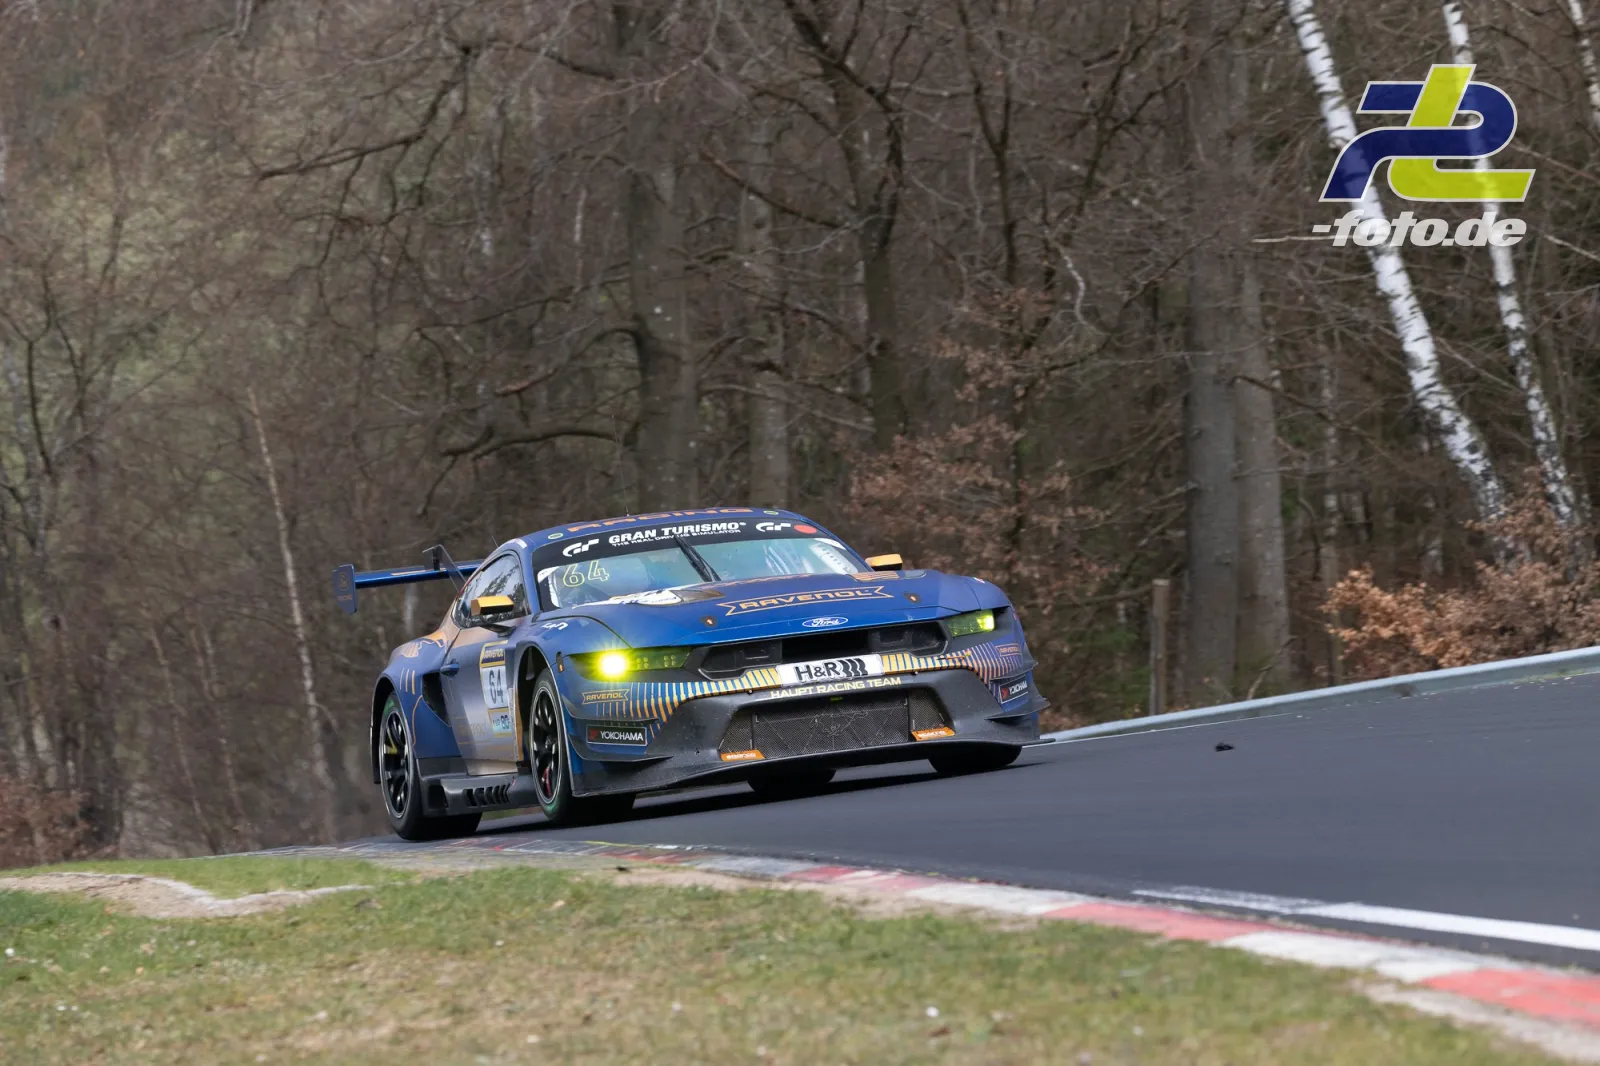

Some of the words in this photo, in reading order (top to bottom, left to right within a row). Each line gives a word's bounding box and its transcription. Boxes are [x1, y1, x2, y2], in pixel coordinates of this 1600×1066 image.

[608, 529, 657, 544] GRAN
[661, 522, 740, 536] TURISMO
[631, 537, 654, 545] REAL
[655, 533, 691, 541] DRIVNG
[691, 529, 741, 537] SIMULATOR
[562, 560, 610, 588] 64
[739, 588, 872, 610] RAVENOL
[811, 618, 840, 628] Ford
[794, 661, 841, 681] H&R
[488, 669, 504, 705] 64
[586, 692, 624, 701] RAVENOL
[770, 686, 814, 699] HAUPT
[816, 681, 865, 693] RACING
[866, 676, 901, 688] TEAM
[600, 730, 644, 741] YOKOHAMA
